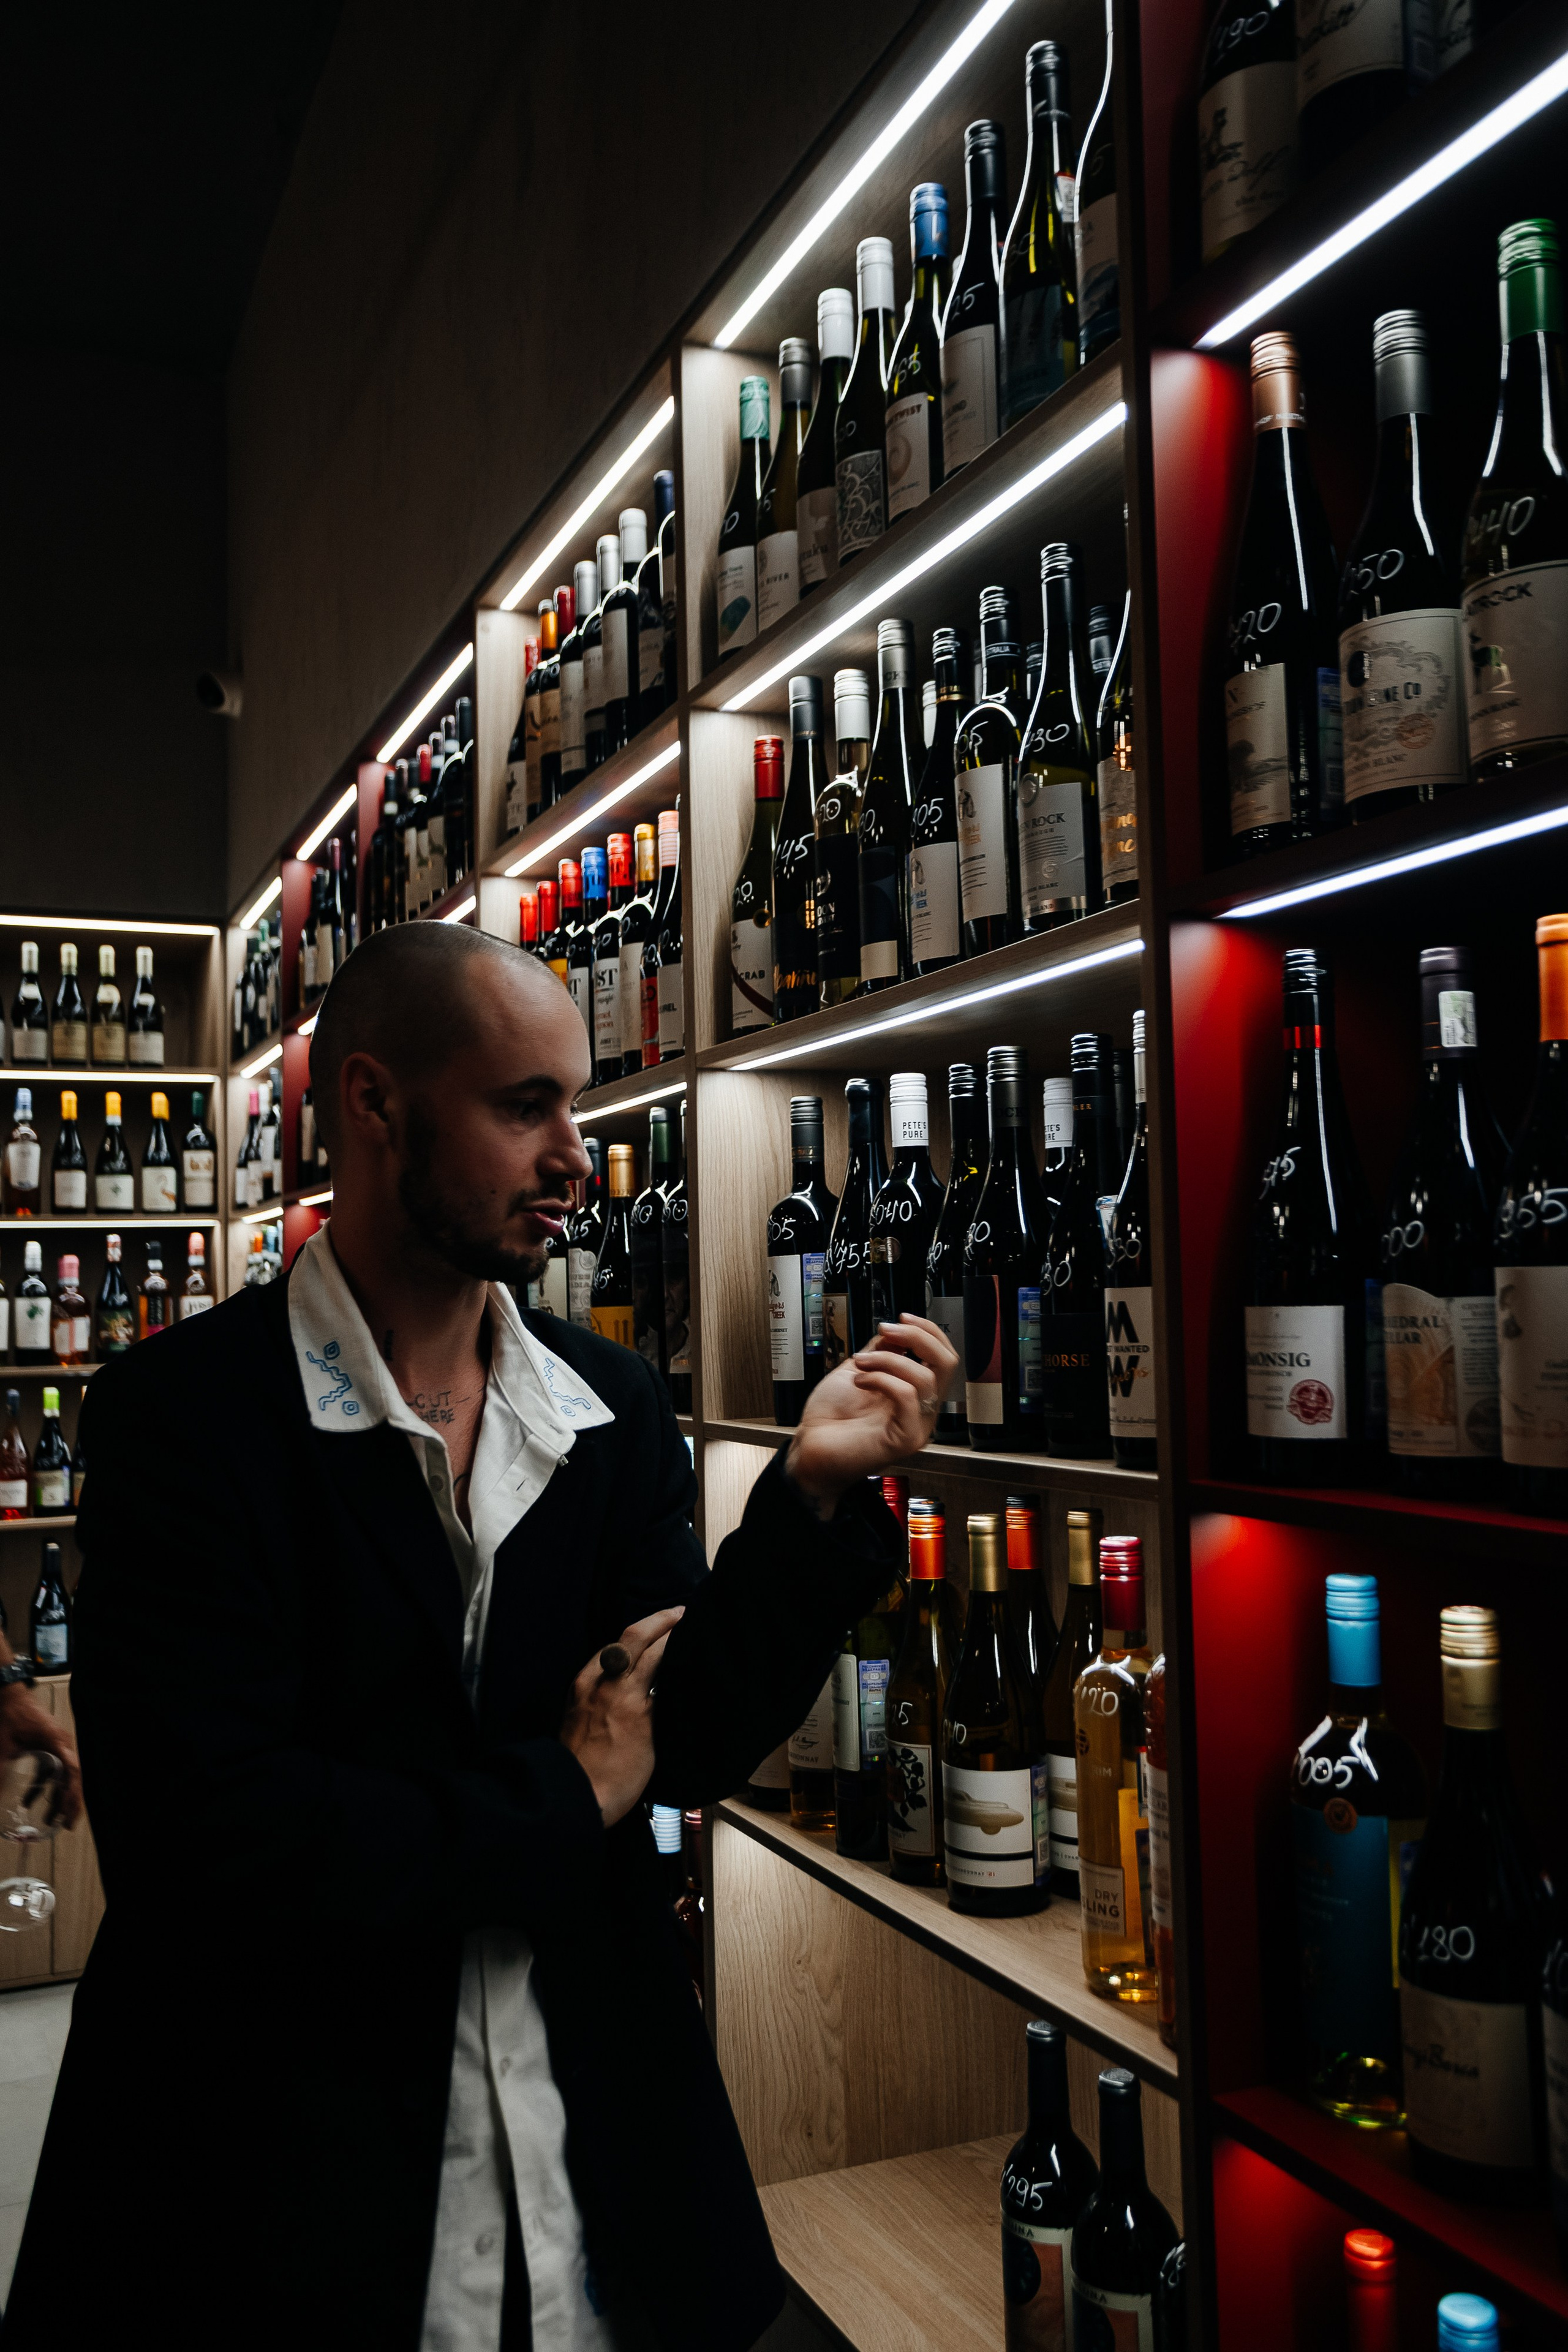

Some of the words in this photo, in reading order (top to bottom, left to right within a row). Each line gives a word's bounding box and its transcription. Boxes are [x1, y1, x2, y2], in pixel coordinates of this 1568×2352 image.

[1032, 812, 1066, 828] ROCK
[739, 969, 766, 981] CRAB
[902, 1121, 927, 1129] PETE'S
[902, 1130, 924, 1139] PURE
[1114, 1344, 1150, 1354] WANTED
[1043, 1354, 1092, 1368] HORSE
[415, 1390, 451, 1409] CUT
[1094, 1888, 1119, 1901] DRY
